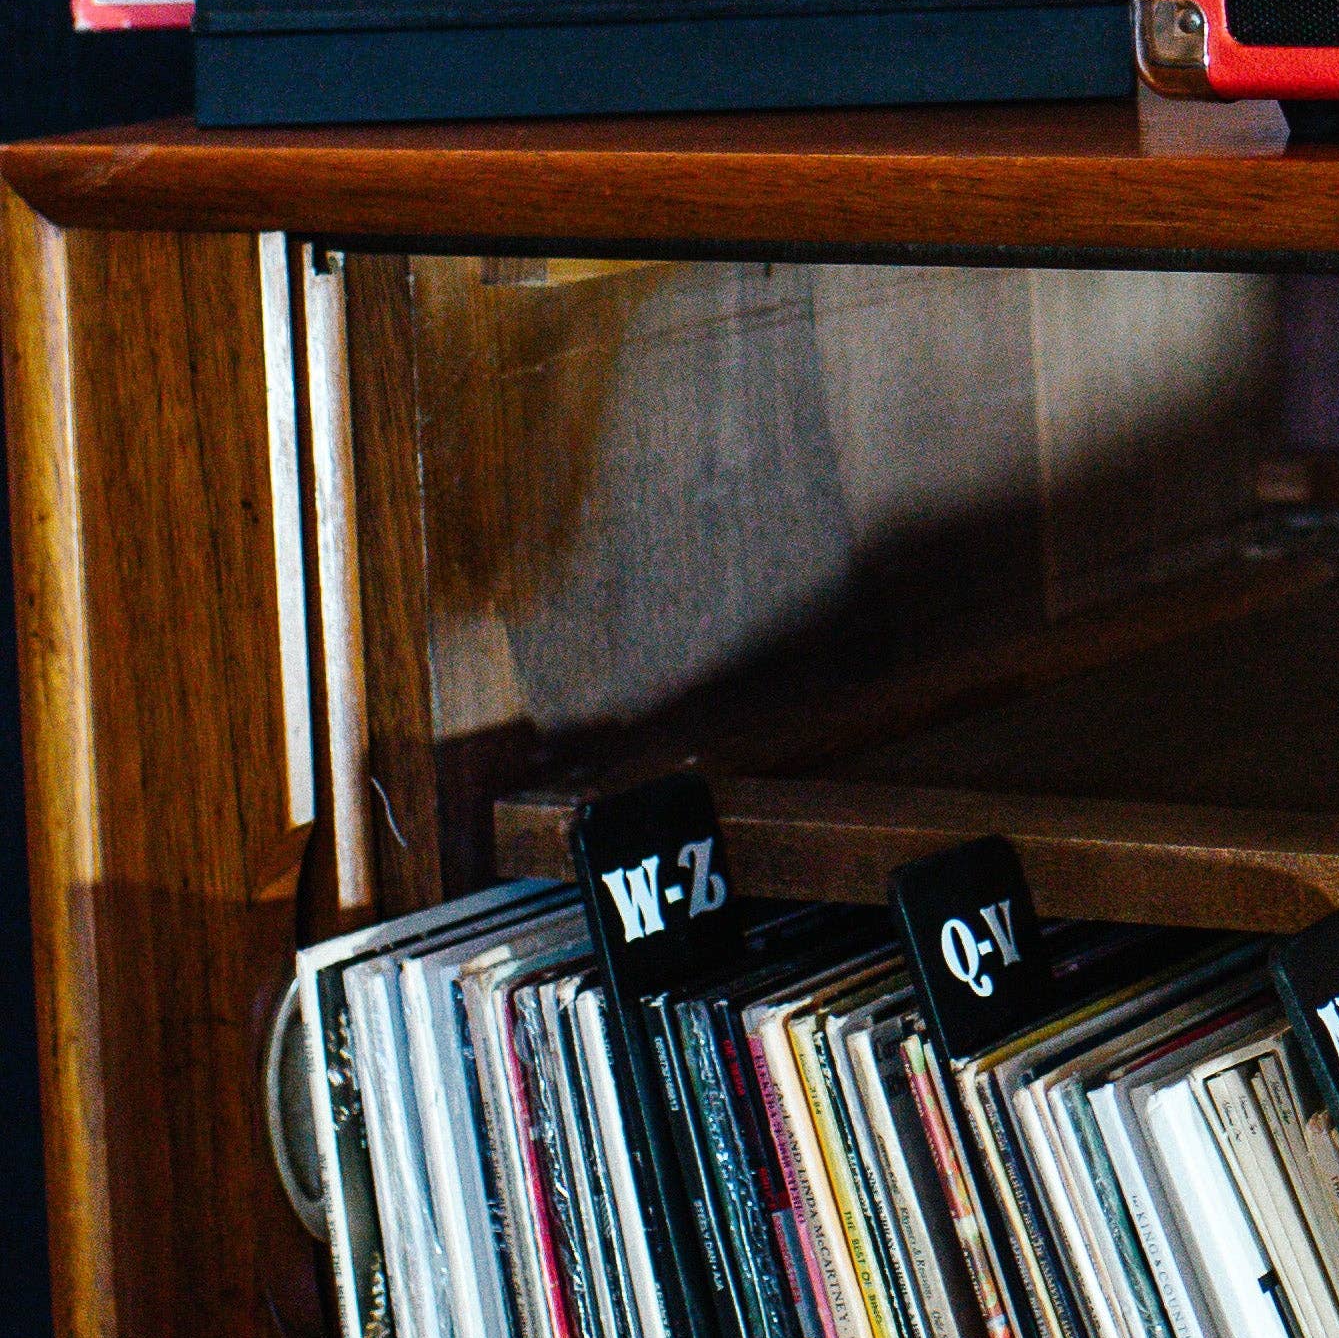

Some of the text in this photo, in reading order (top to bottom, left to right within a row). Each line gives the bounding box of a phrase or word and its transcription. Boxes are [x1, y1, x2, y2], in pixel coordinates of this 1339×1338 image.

[600, 835, 729, 944] W-Z
[939, 896, 1024, 999] Q-V
[692, 1198, 724, 1291] STEELY DAN AJA
[785, 1127, 804, 1164] AND
[796, 1167, 820, 1220] LINDA
[812, 1222, 850, 1327] McCARTNEY
[842, 1210, 857, 1233] THE
[850, 1237, 866, 1265] BEST
[860, 1270, 872, 1288] OF
[1135, 1210, 1160, 1255] KING
